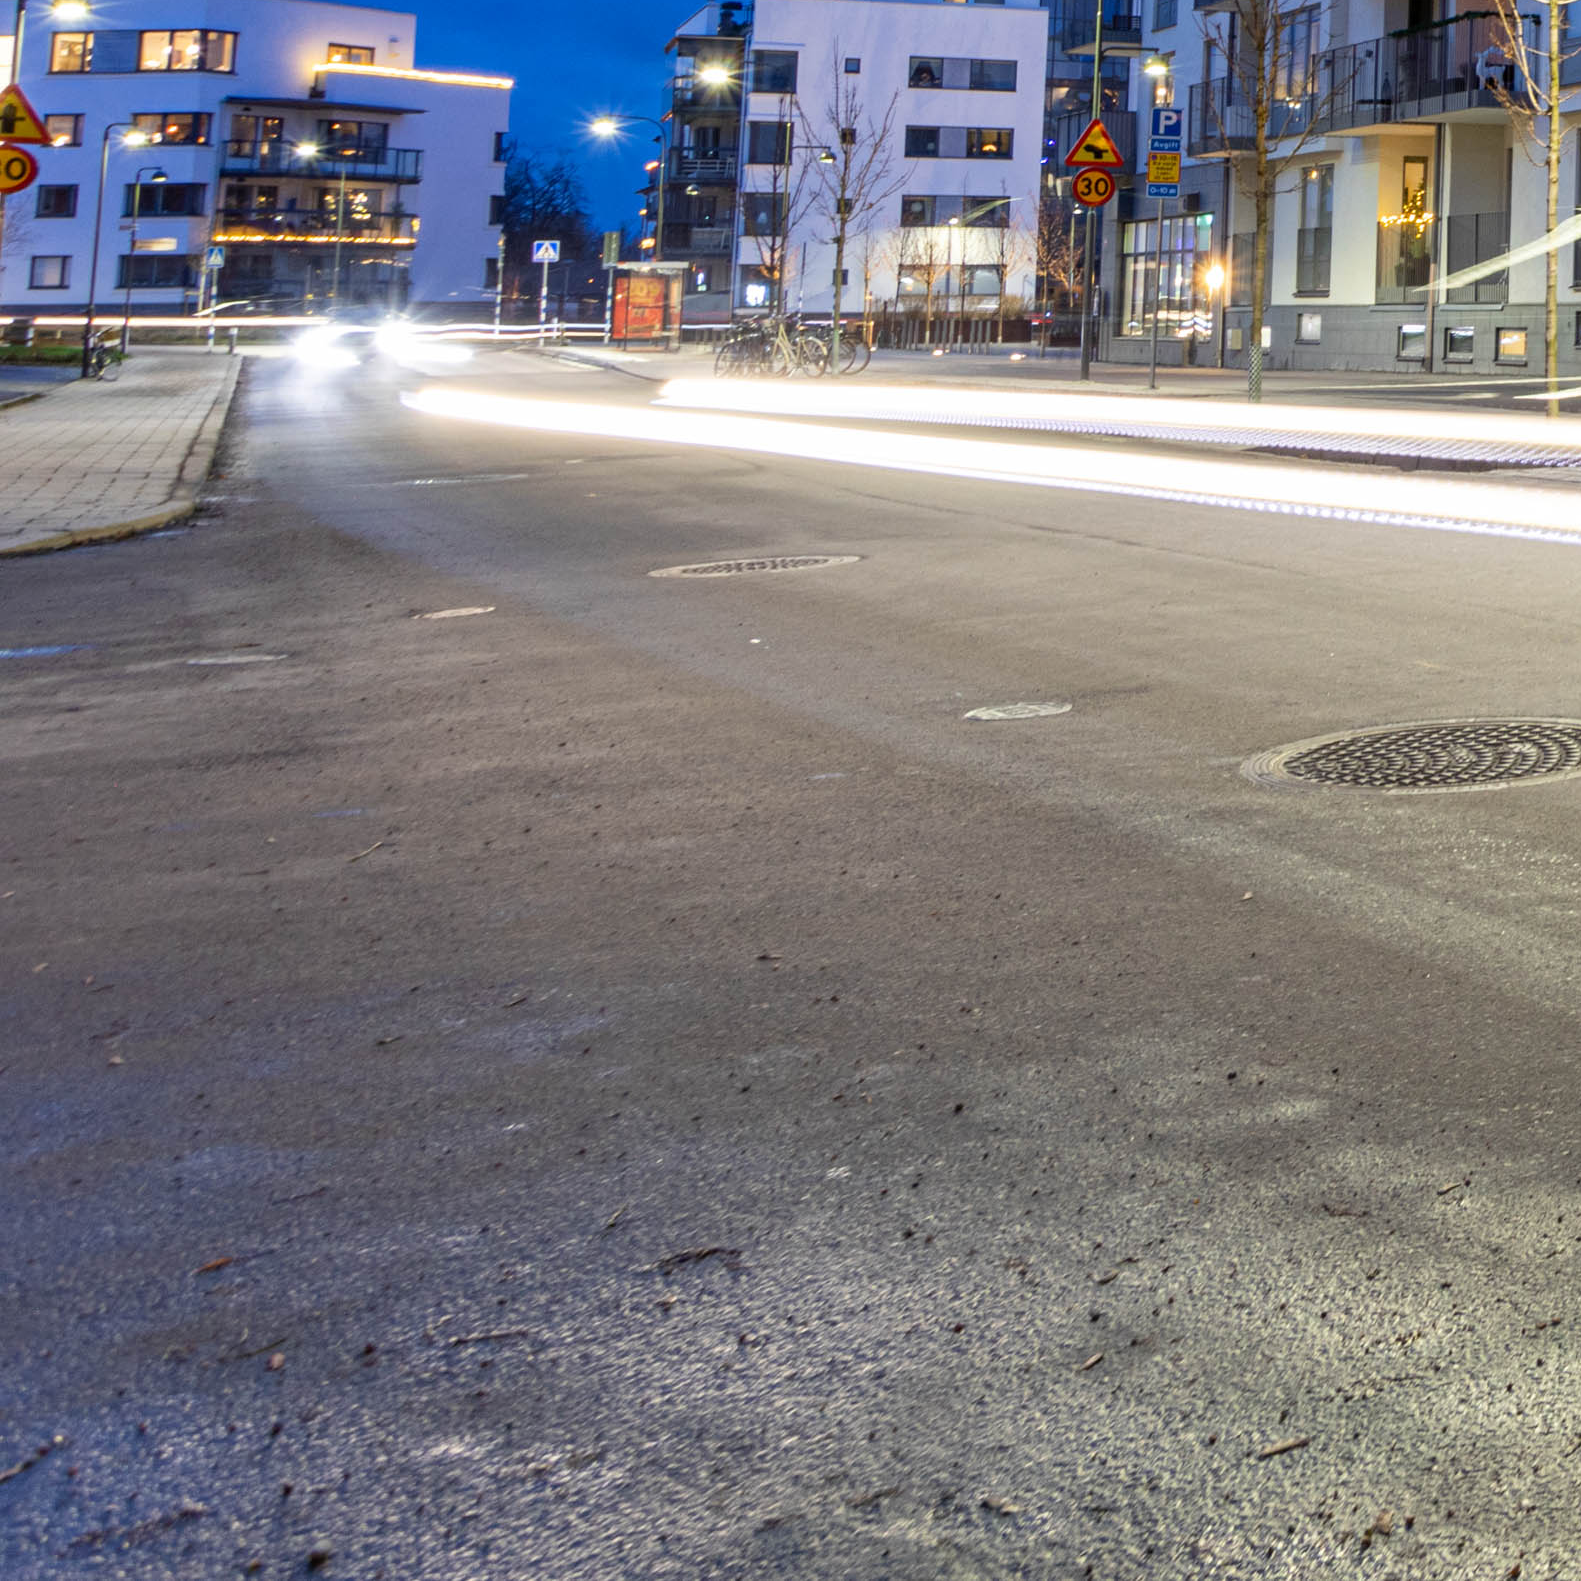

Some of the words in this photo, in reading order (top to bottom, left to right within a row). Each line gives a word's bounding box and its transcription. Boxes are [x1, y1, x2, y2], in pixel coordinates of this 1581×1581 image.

[1159, 111, 1177, 134] P
[1153, 141, 1178, 149] Avgift
[1080, 177, 1109, 196] 30
